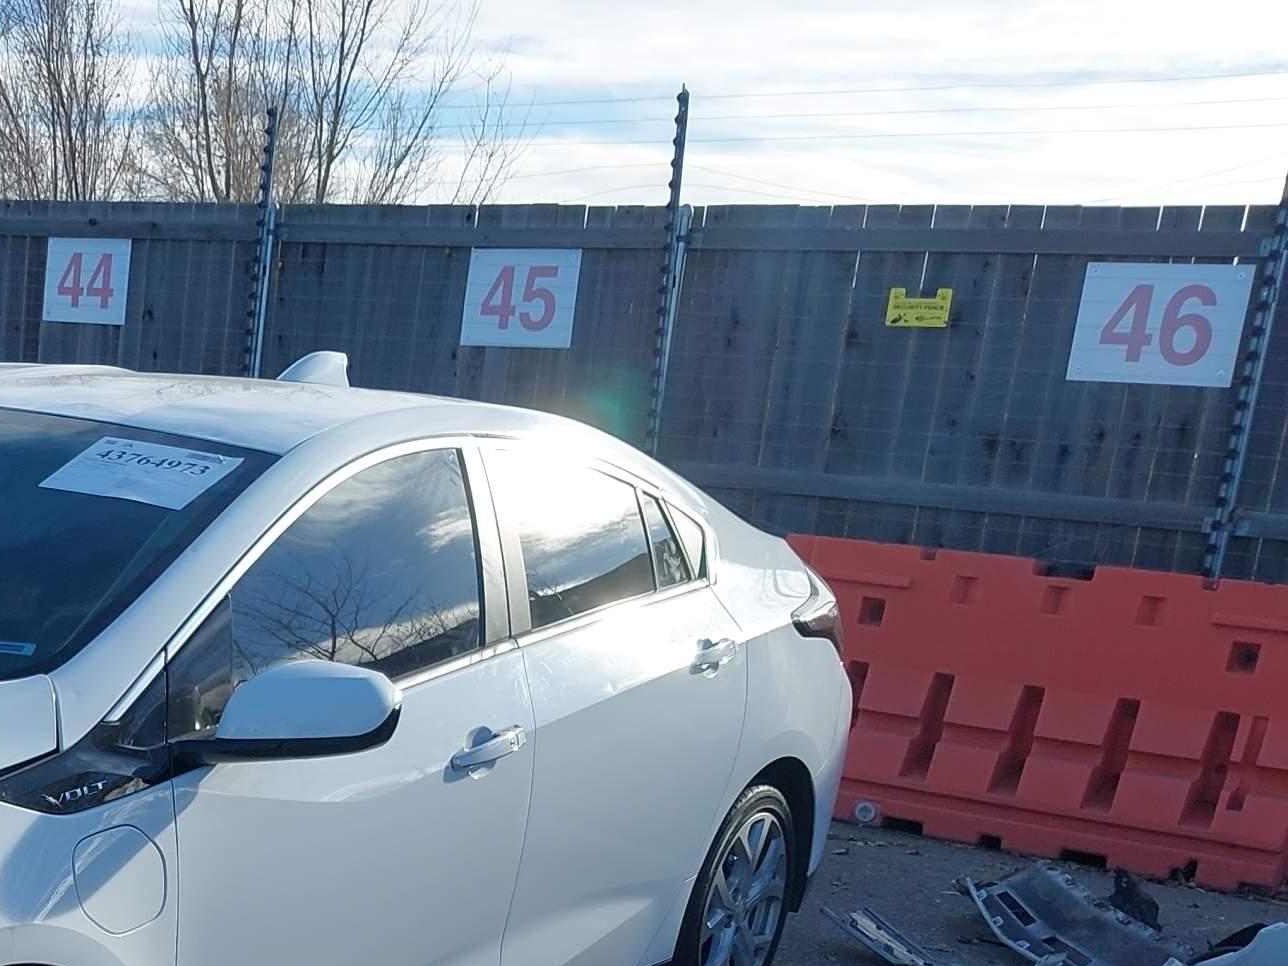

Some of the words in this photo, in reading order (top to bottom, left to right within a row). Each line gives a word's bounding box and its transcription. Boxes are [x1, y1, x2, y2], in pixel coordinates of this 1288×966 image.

[56, 252, 114, 309] 44
[480, 265, 560, 332] 45
[1099, 283, 1217, 367] 46
[96, 448, 212, 476] 43764973
[41, 780, 108, 808] VOLT
